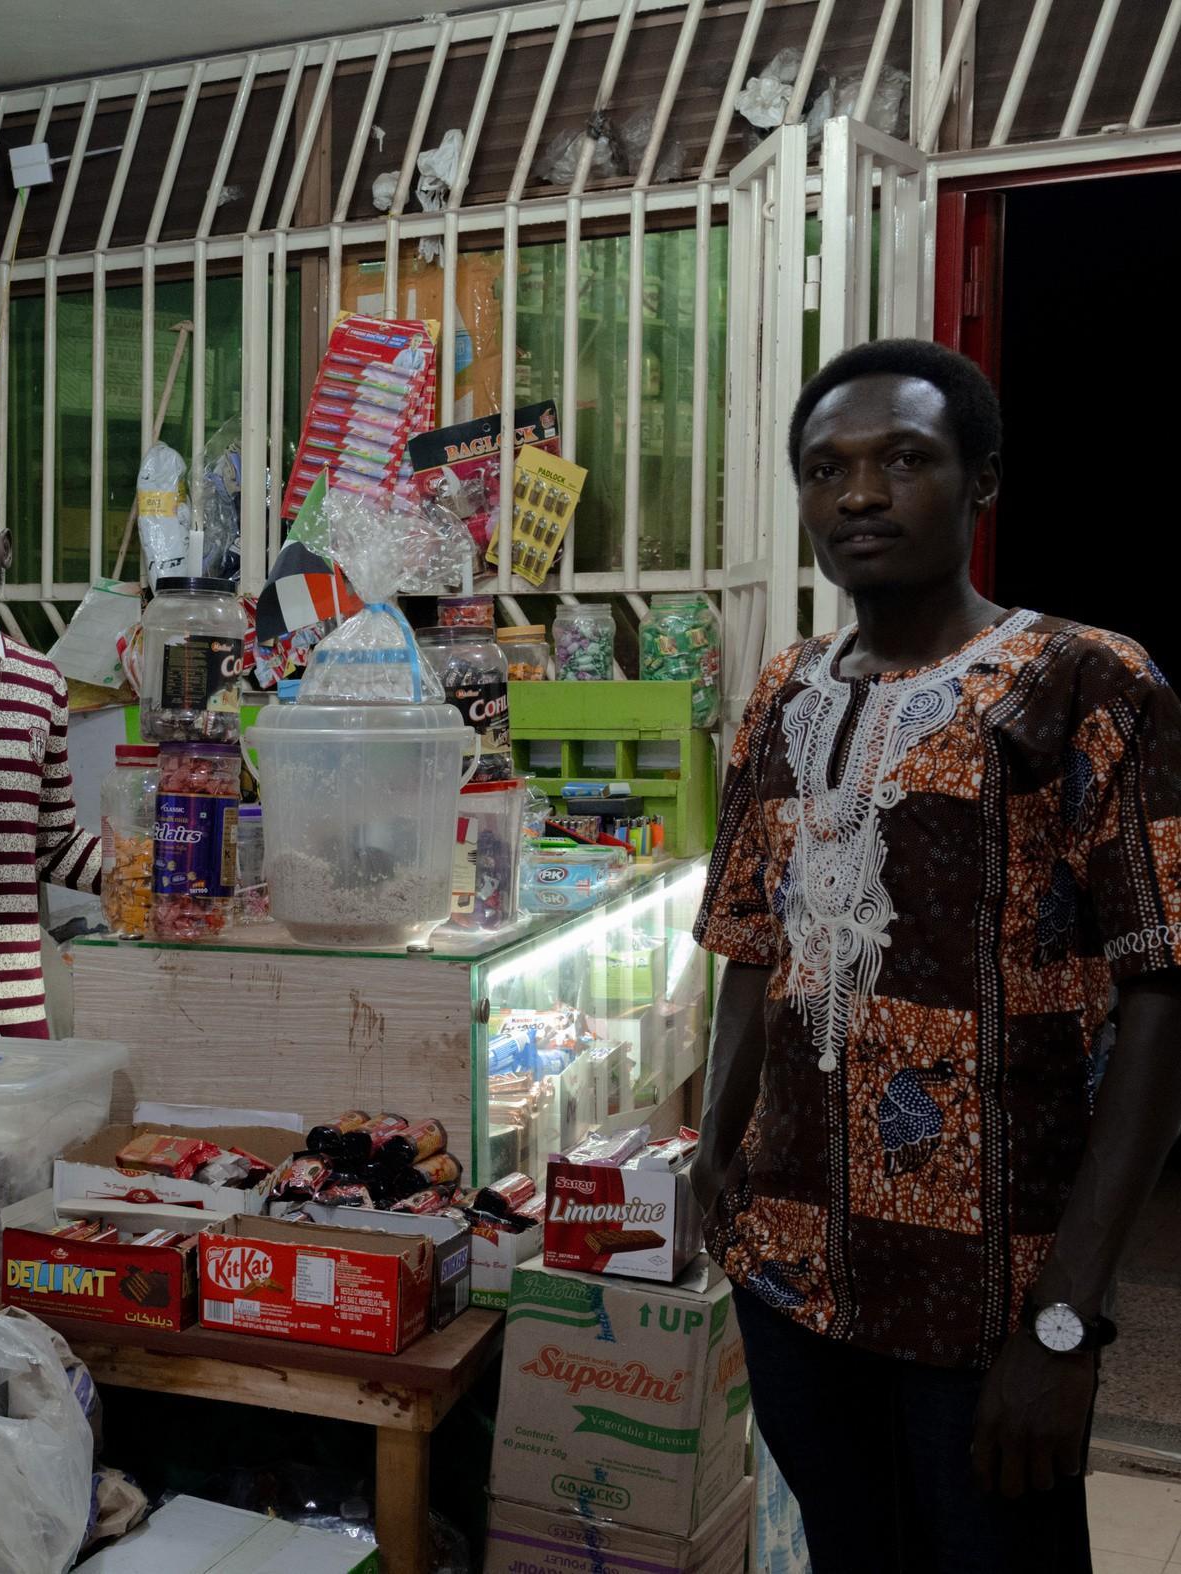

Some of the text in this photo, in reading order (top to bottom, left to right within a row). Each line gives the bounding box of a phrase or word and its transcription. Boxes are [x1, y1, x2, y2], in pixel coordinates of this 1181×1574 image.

[537, 466, 566, 484] PADLOCK
[555, 1175, 597, 1195] Saray
[548, 1196, 667, 1226] Limousine
[214, 1247, 273, 1289] KitKat
[442, 1246, 469, 1282] SNICKERS
[472, 1292, 507, 1308] Cakes
[658, 1303, 704, 1336] UP
[515, 1425, 559, 1443] Contents:
[589, 1413, 694, 1447] Vegetable Flavour
[503, 1437, 514, 1448] 40
[514, 1440, 542, 1458] packs
[550, 1447, 568, 1461] 50g
[558, 1479, 624, 1505] 40 PACKS
[543, 1554, 587, 1570] POULET
